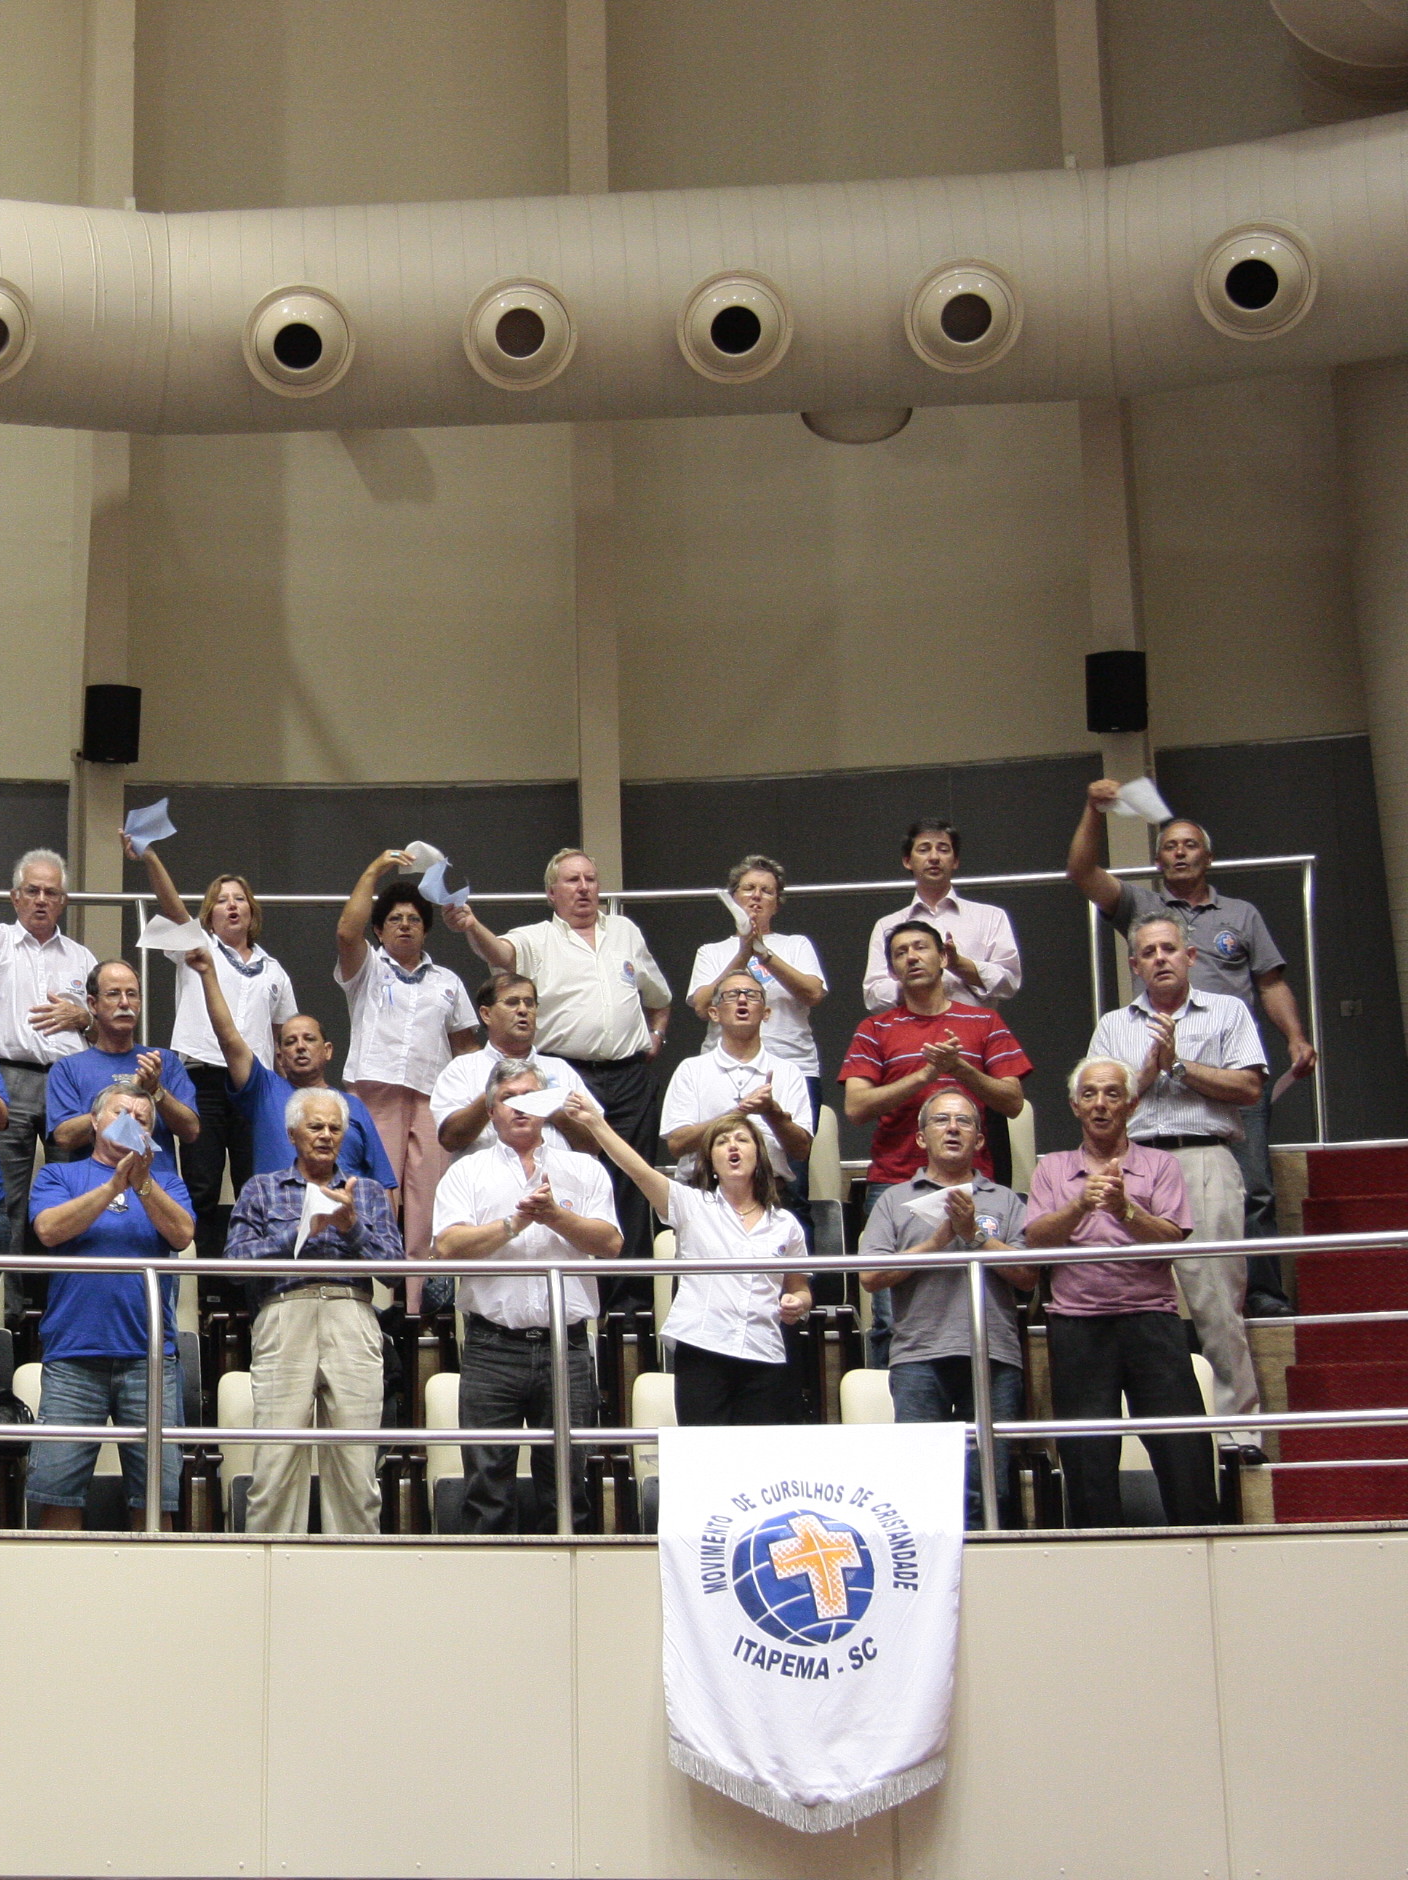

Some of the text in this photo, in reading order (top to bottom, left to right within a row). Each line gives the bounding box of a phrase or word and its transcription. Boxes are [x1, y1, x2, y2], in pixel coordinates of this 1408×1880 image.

[700, 1479, 919, 1595] MOVIMENTO DE CURSILHOS DE CRISTANDADE
[732, 1634, 830, 1680] ITAPEMA
[848, 1636, 878, 1670] SC
